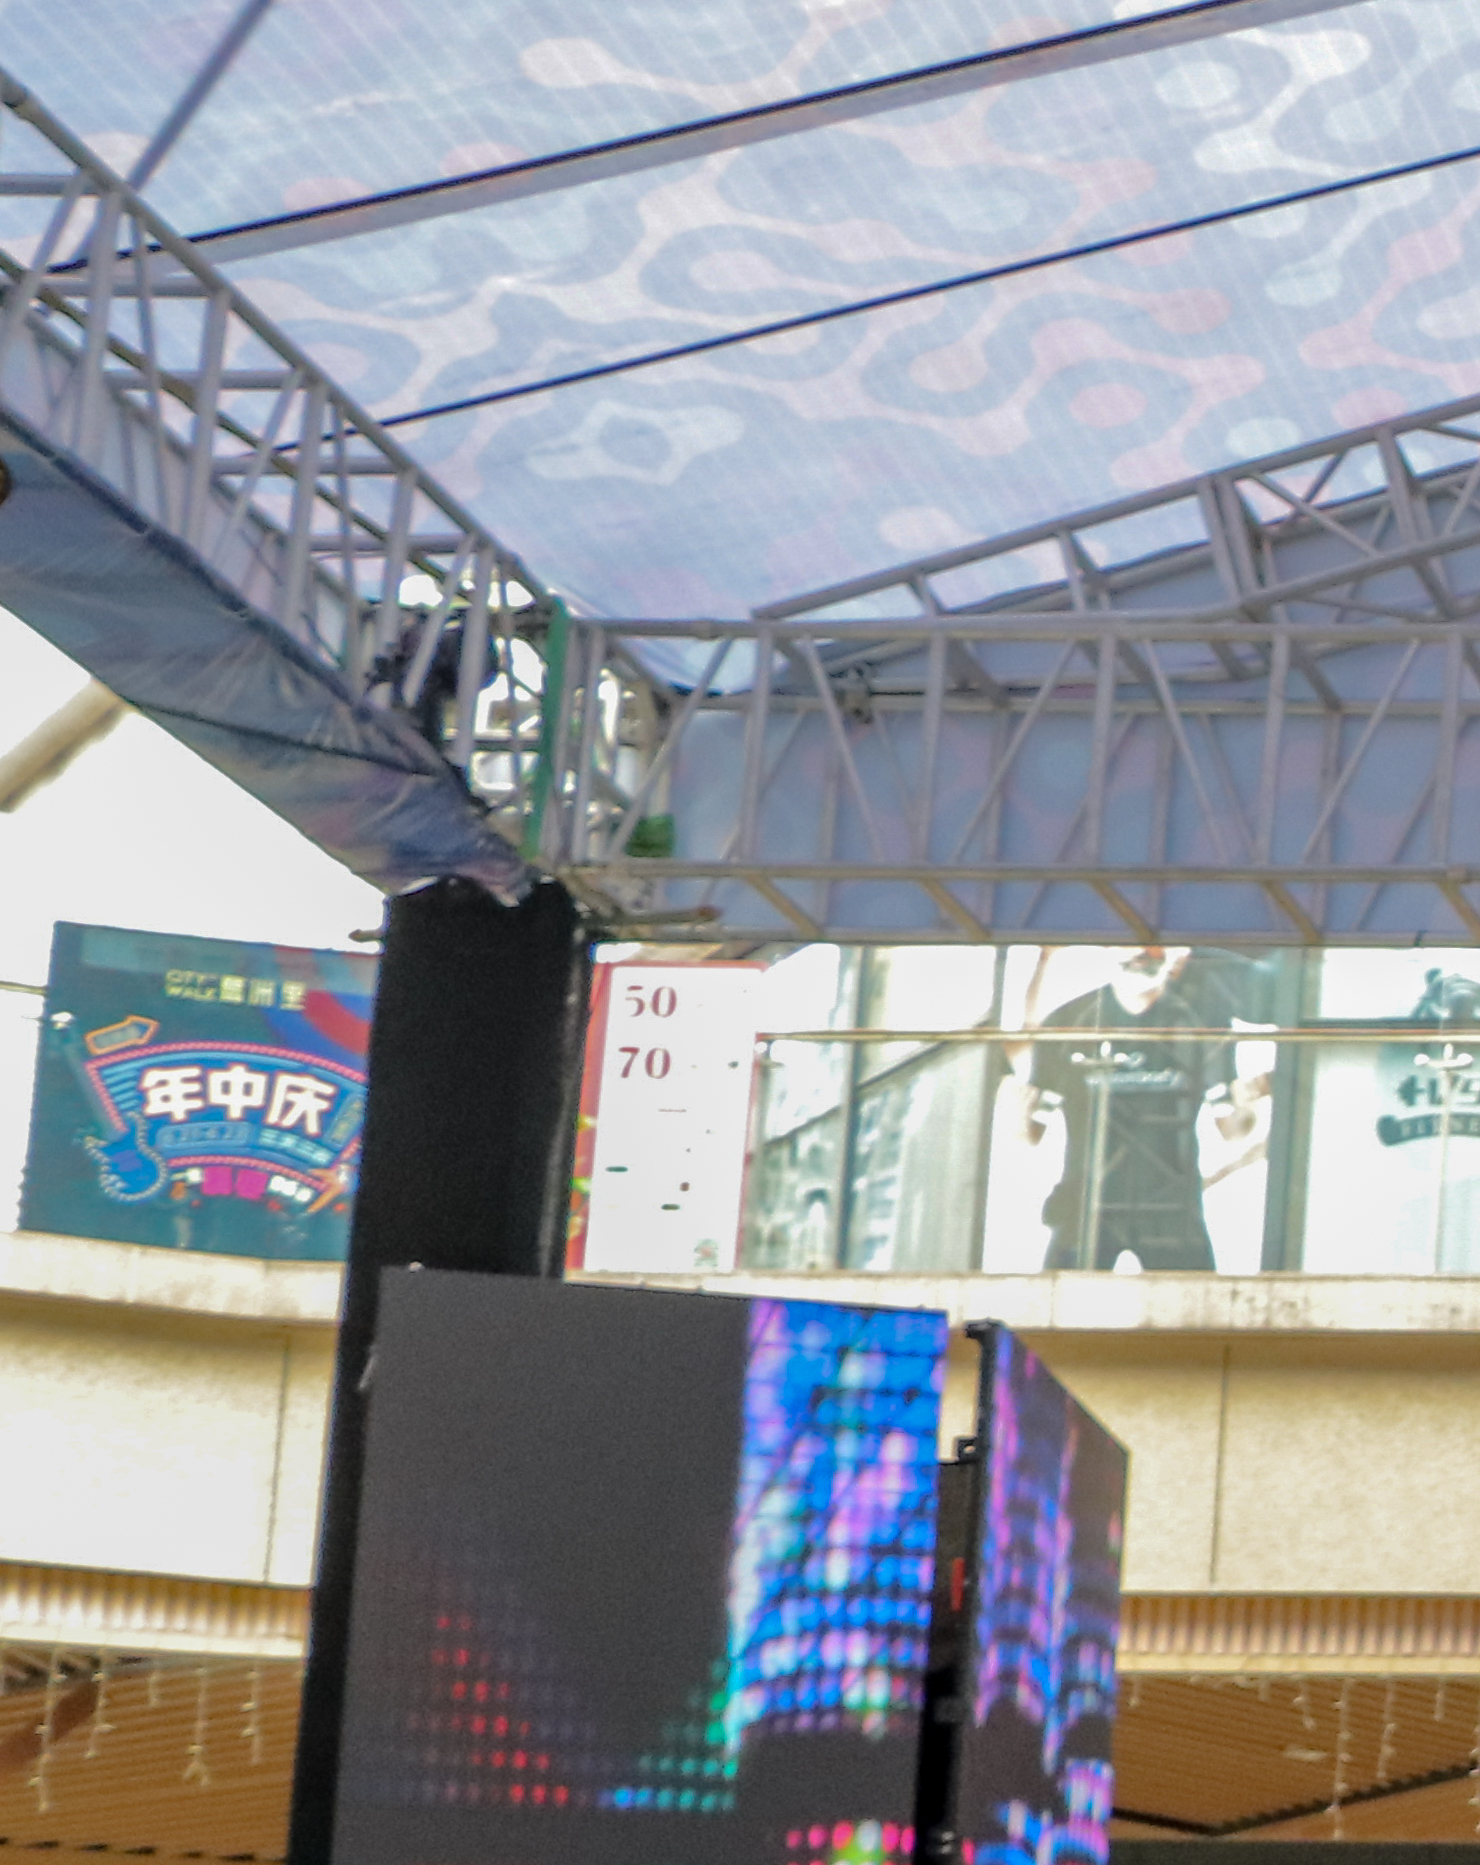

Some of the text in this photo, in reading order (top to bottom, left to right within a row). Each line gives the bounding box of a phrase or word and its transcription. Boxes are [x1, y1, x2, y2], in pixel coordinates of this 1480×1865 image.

[625, 985, 677, 1018] 50
[618, 1046, 671, 1079] 70
[141, 1063, 338, 1136] 年中庆
